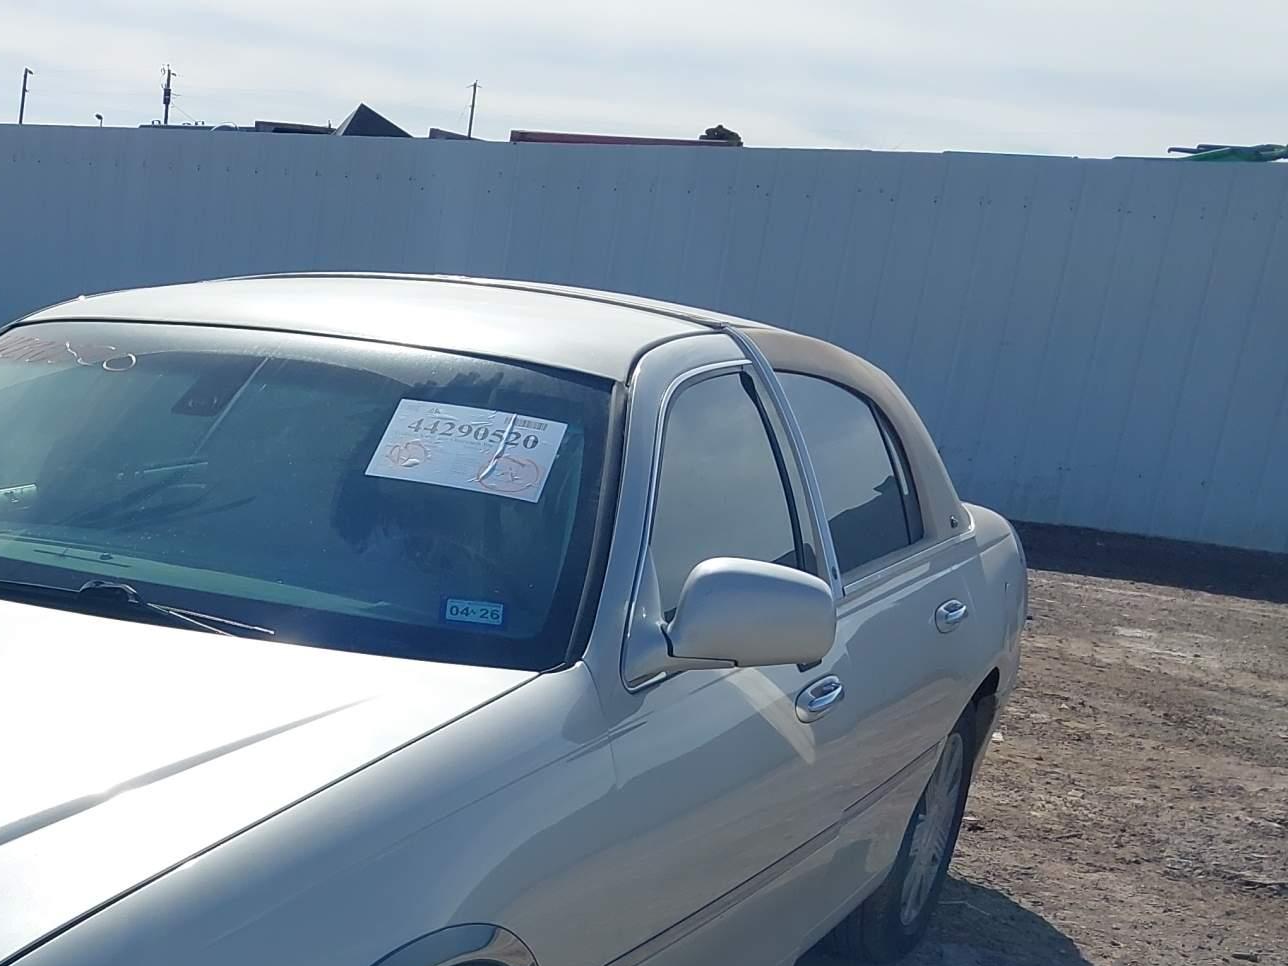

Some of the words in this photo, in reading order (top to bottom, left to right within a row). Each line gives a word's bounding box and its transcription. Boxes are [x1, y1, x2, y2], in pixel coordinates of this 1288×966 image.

[408, 418, 539, 450] 44290520
[450, 605, 471, 617] 04
[479, 608, 501, 620] 26
